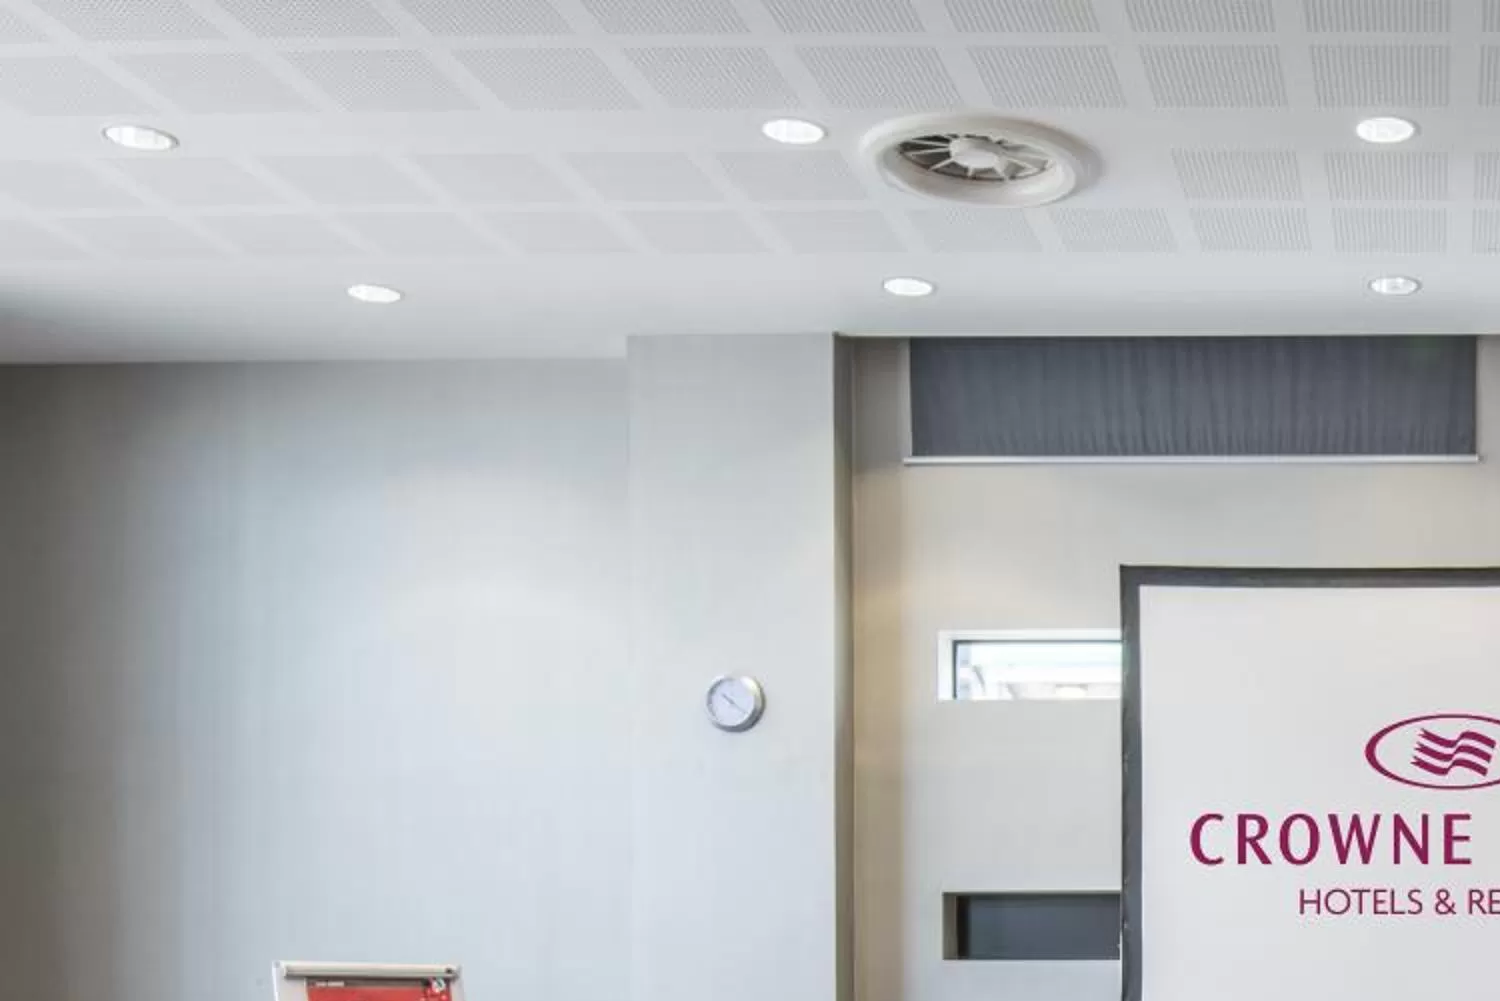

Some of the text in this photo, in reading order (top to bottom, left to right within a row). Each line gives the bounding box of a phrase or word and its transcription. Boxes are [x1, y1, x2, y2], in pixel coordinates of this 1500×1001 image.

[1189, 813, 1473, 866] CROWNE
[1299, 888, 1423, 916] HOTELS
[1434, 888, 1457, 916] &
